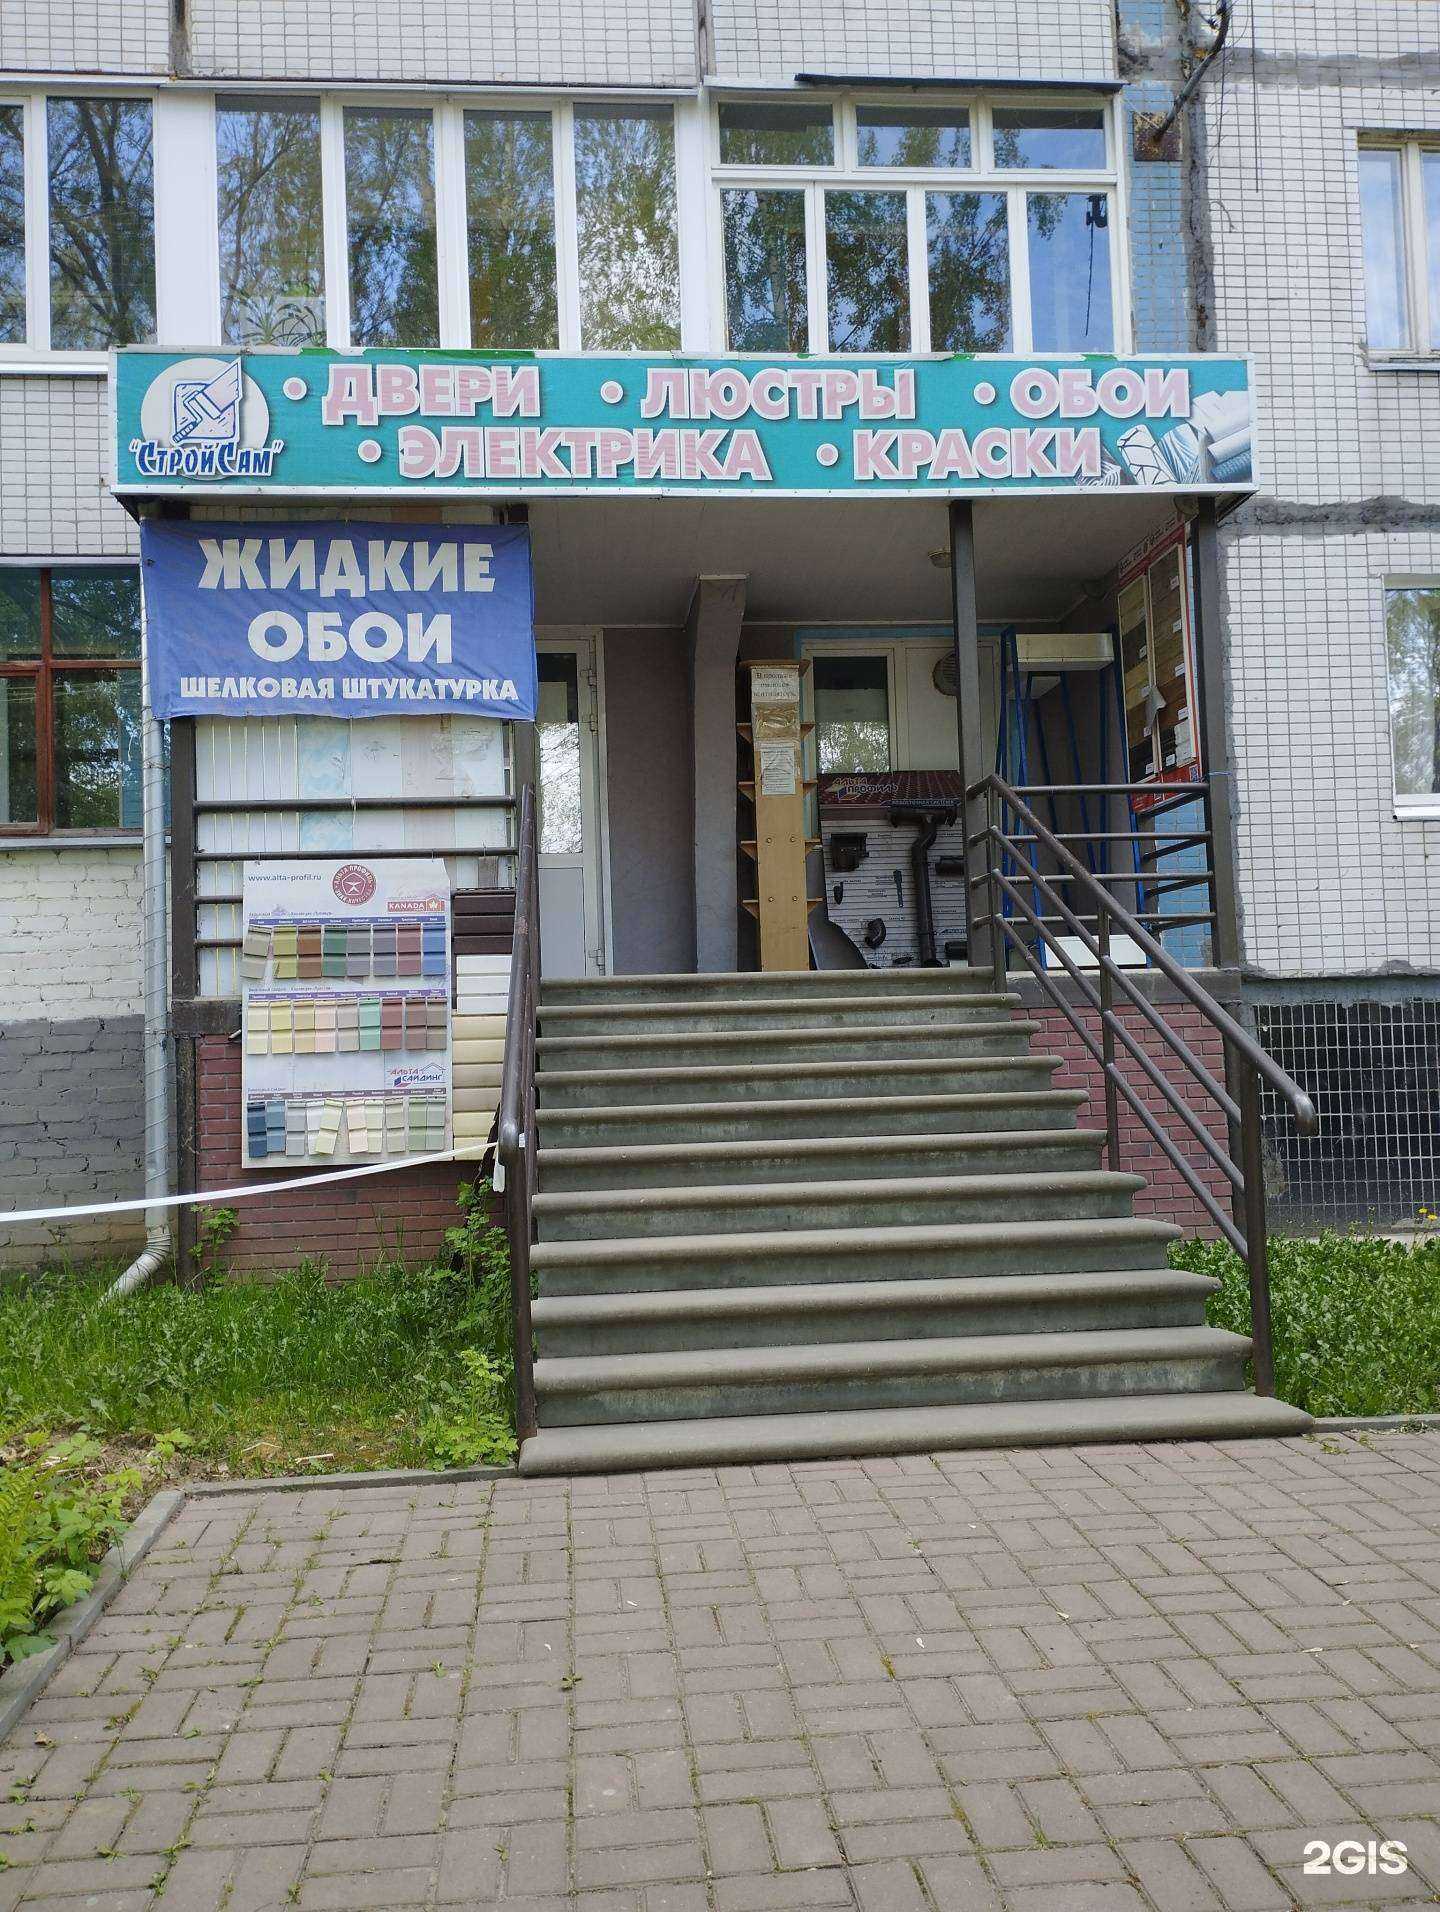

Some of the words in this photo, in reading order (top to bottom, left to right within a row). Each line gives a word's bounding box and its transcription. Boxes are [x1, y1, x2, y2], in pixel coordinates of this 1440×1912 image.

[321, 363, 541, 426] ДВЕРИ
[640, 366, 916, 420] ЛЮСТРЫ
[1009, 366, 1191, 419] ОБОИ
[398, 425, 774, 481] ЭЛЕКТРИКА
[852, 426, 1102, 481] КРАСКИ
[198, 538, 496, 597] ЖИДКИЕ
[247, 610, 454, 664] ОБОИ
[180, 677, 334, 700] ШЕЛКОВАЯ
[342, 678, 518, 701] ШТУКАТУРКА
[248, 873, 322, 882] www.alta-profil.ru
